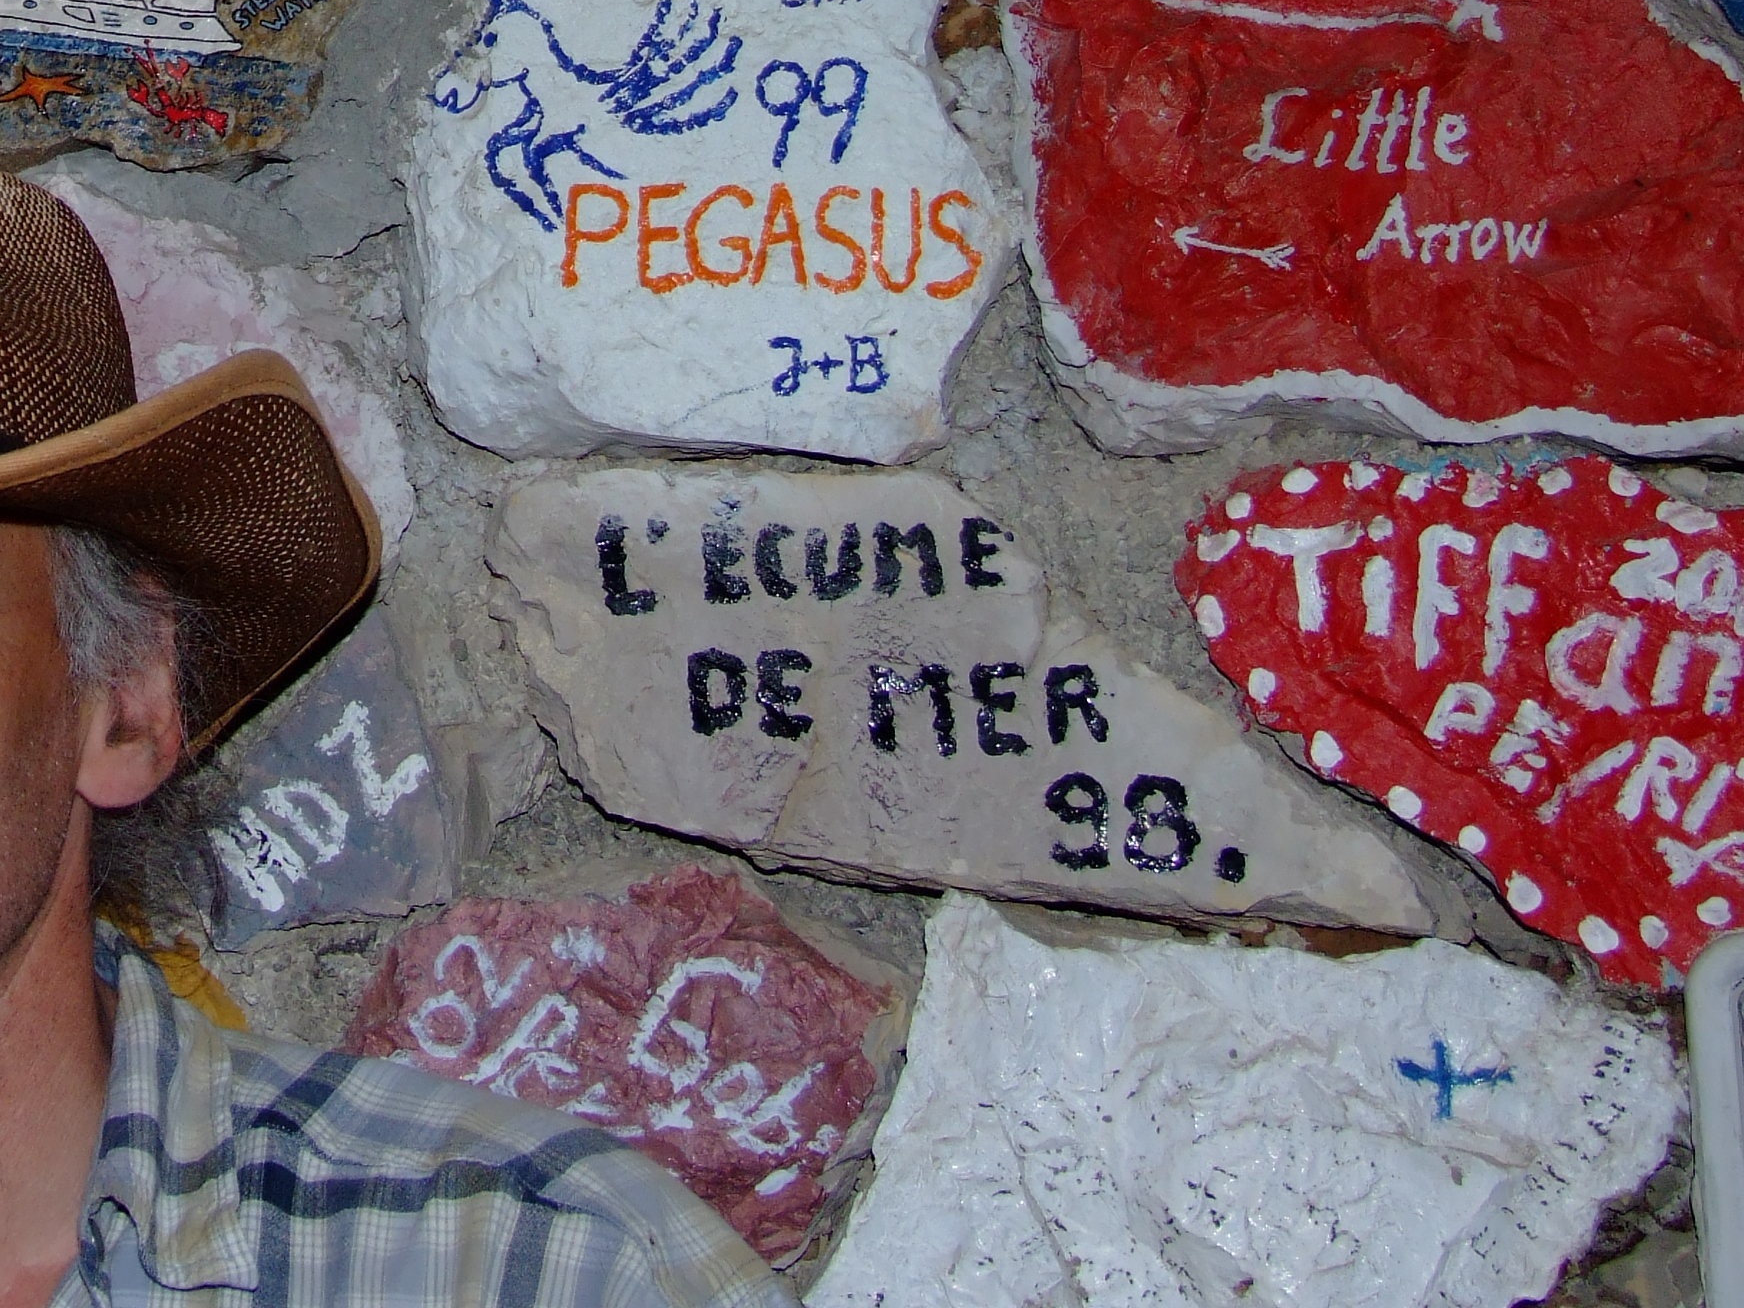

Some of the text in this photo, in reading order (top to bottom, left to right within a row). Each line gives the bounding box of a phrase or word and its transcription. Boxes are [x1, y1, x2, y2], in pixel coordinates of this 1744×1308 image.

[755, 55, 871, 170] 99
[1241, 86, 1471, 175] Little
[560, 180, 984, 302] PEGASUS
[1355, 191, 1550, 266] Arrow
[685, 646, 1110, 759] DE MER
